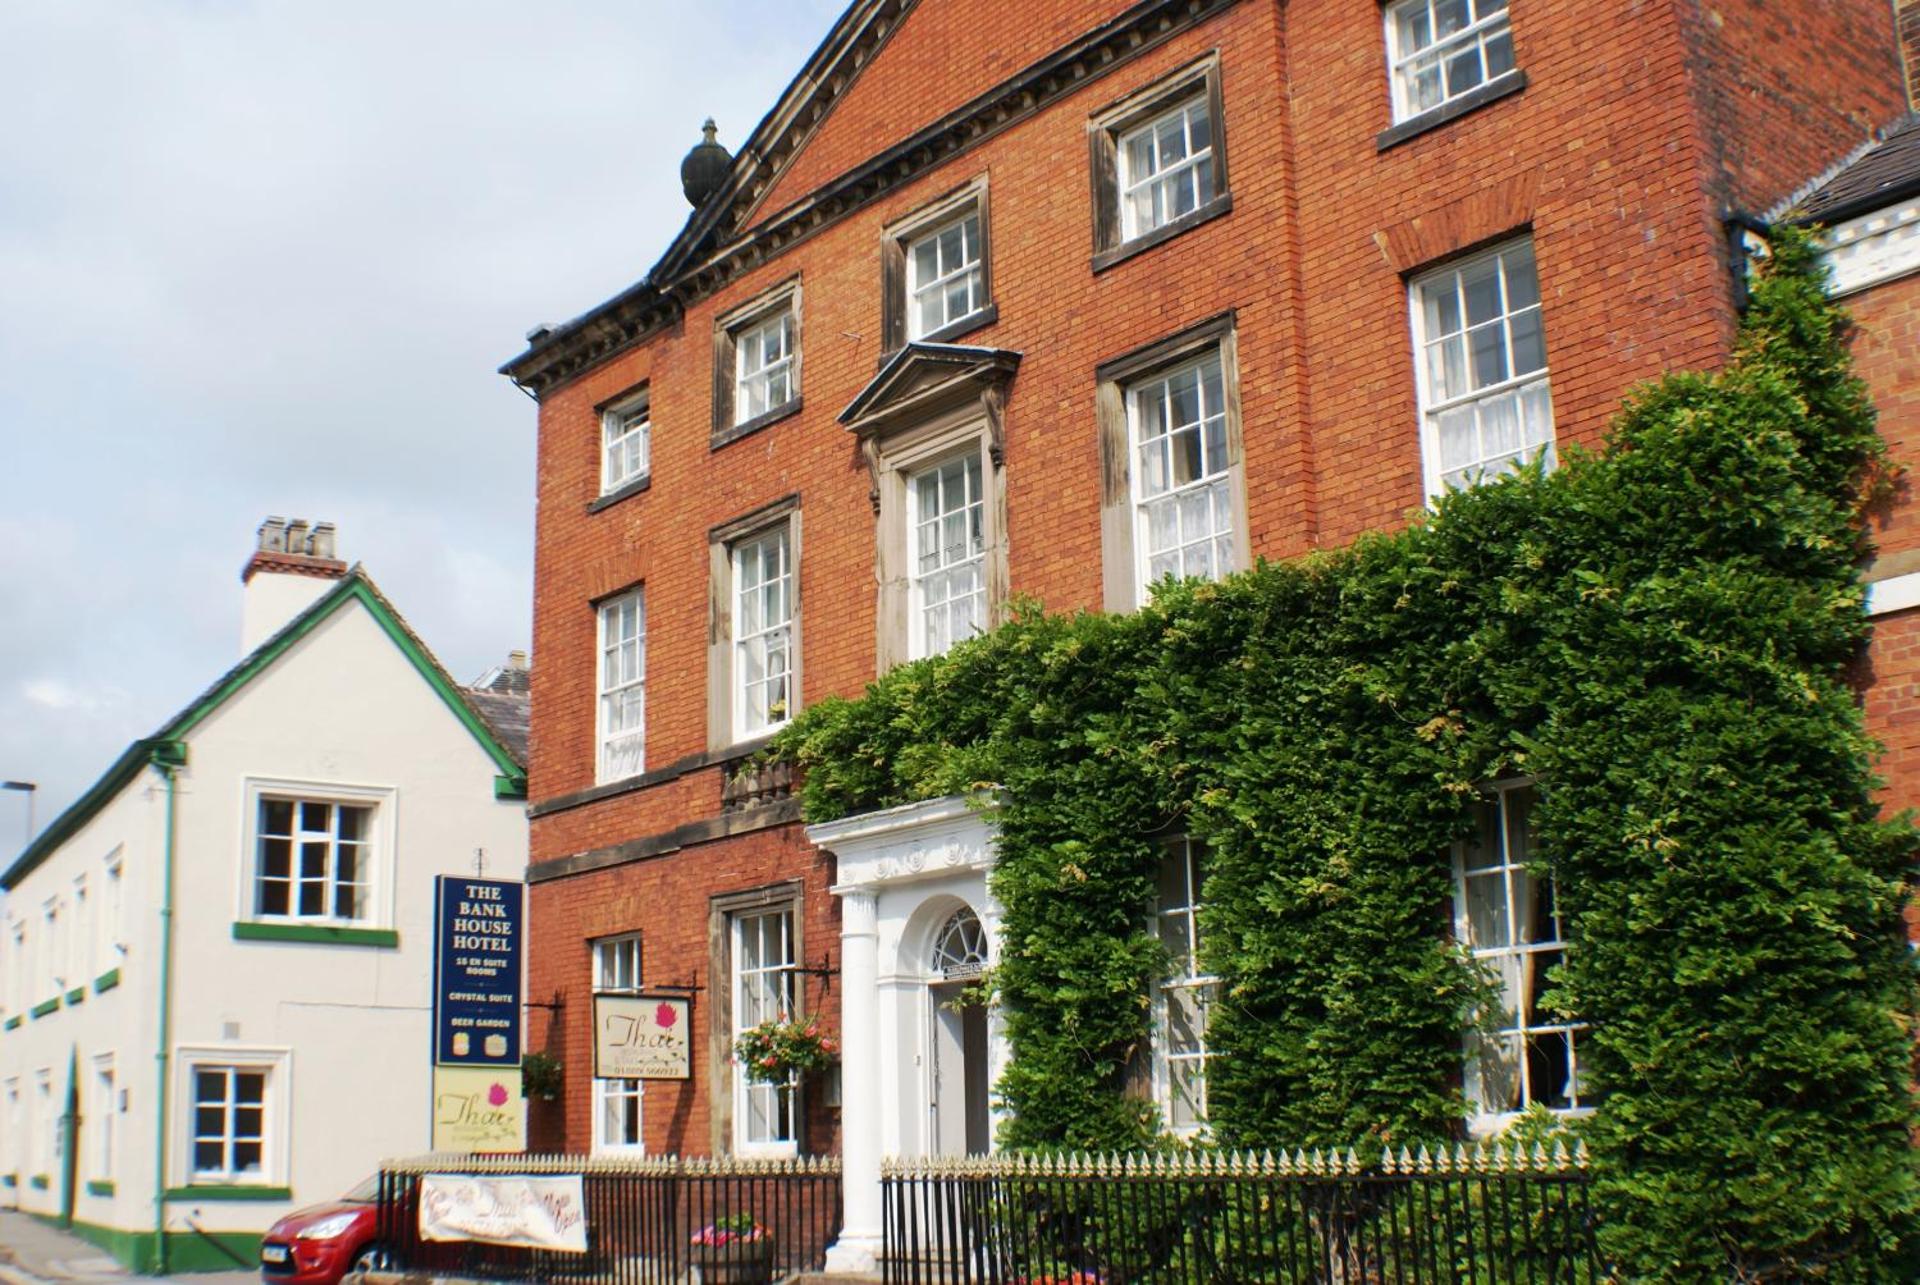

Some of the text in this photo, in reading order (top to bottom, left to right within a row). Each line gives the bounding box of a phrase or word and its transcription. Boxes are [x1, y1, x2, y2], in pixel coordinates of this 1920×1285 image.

[465, 885, 502, 900] THE
[459, 901, 507, 918] BANK
[453, 918, 512, 935] HOUSE
[453, 935, 512, 952] HOTEL
[483, 959, 507, 968] SUITE
[466, 967, 496, 976] ROOMS
[449, 992, 513, 1003] CRYSTAL SUITE
[451, 1017, 510, 1028] BEER GARDEN
